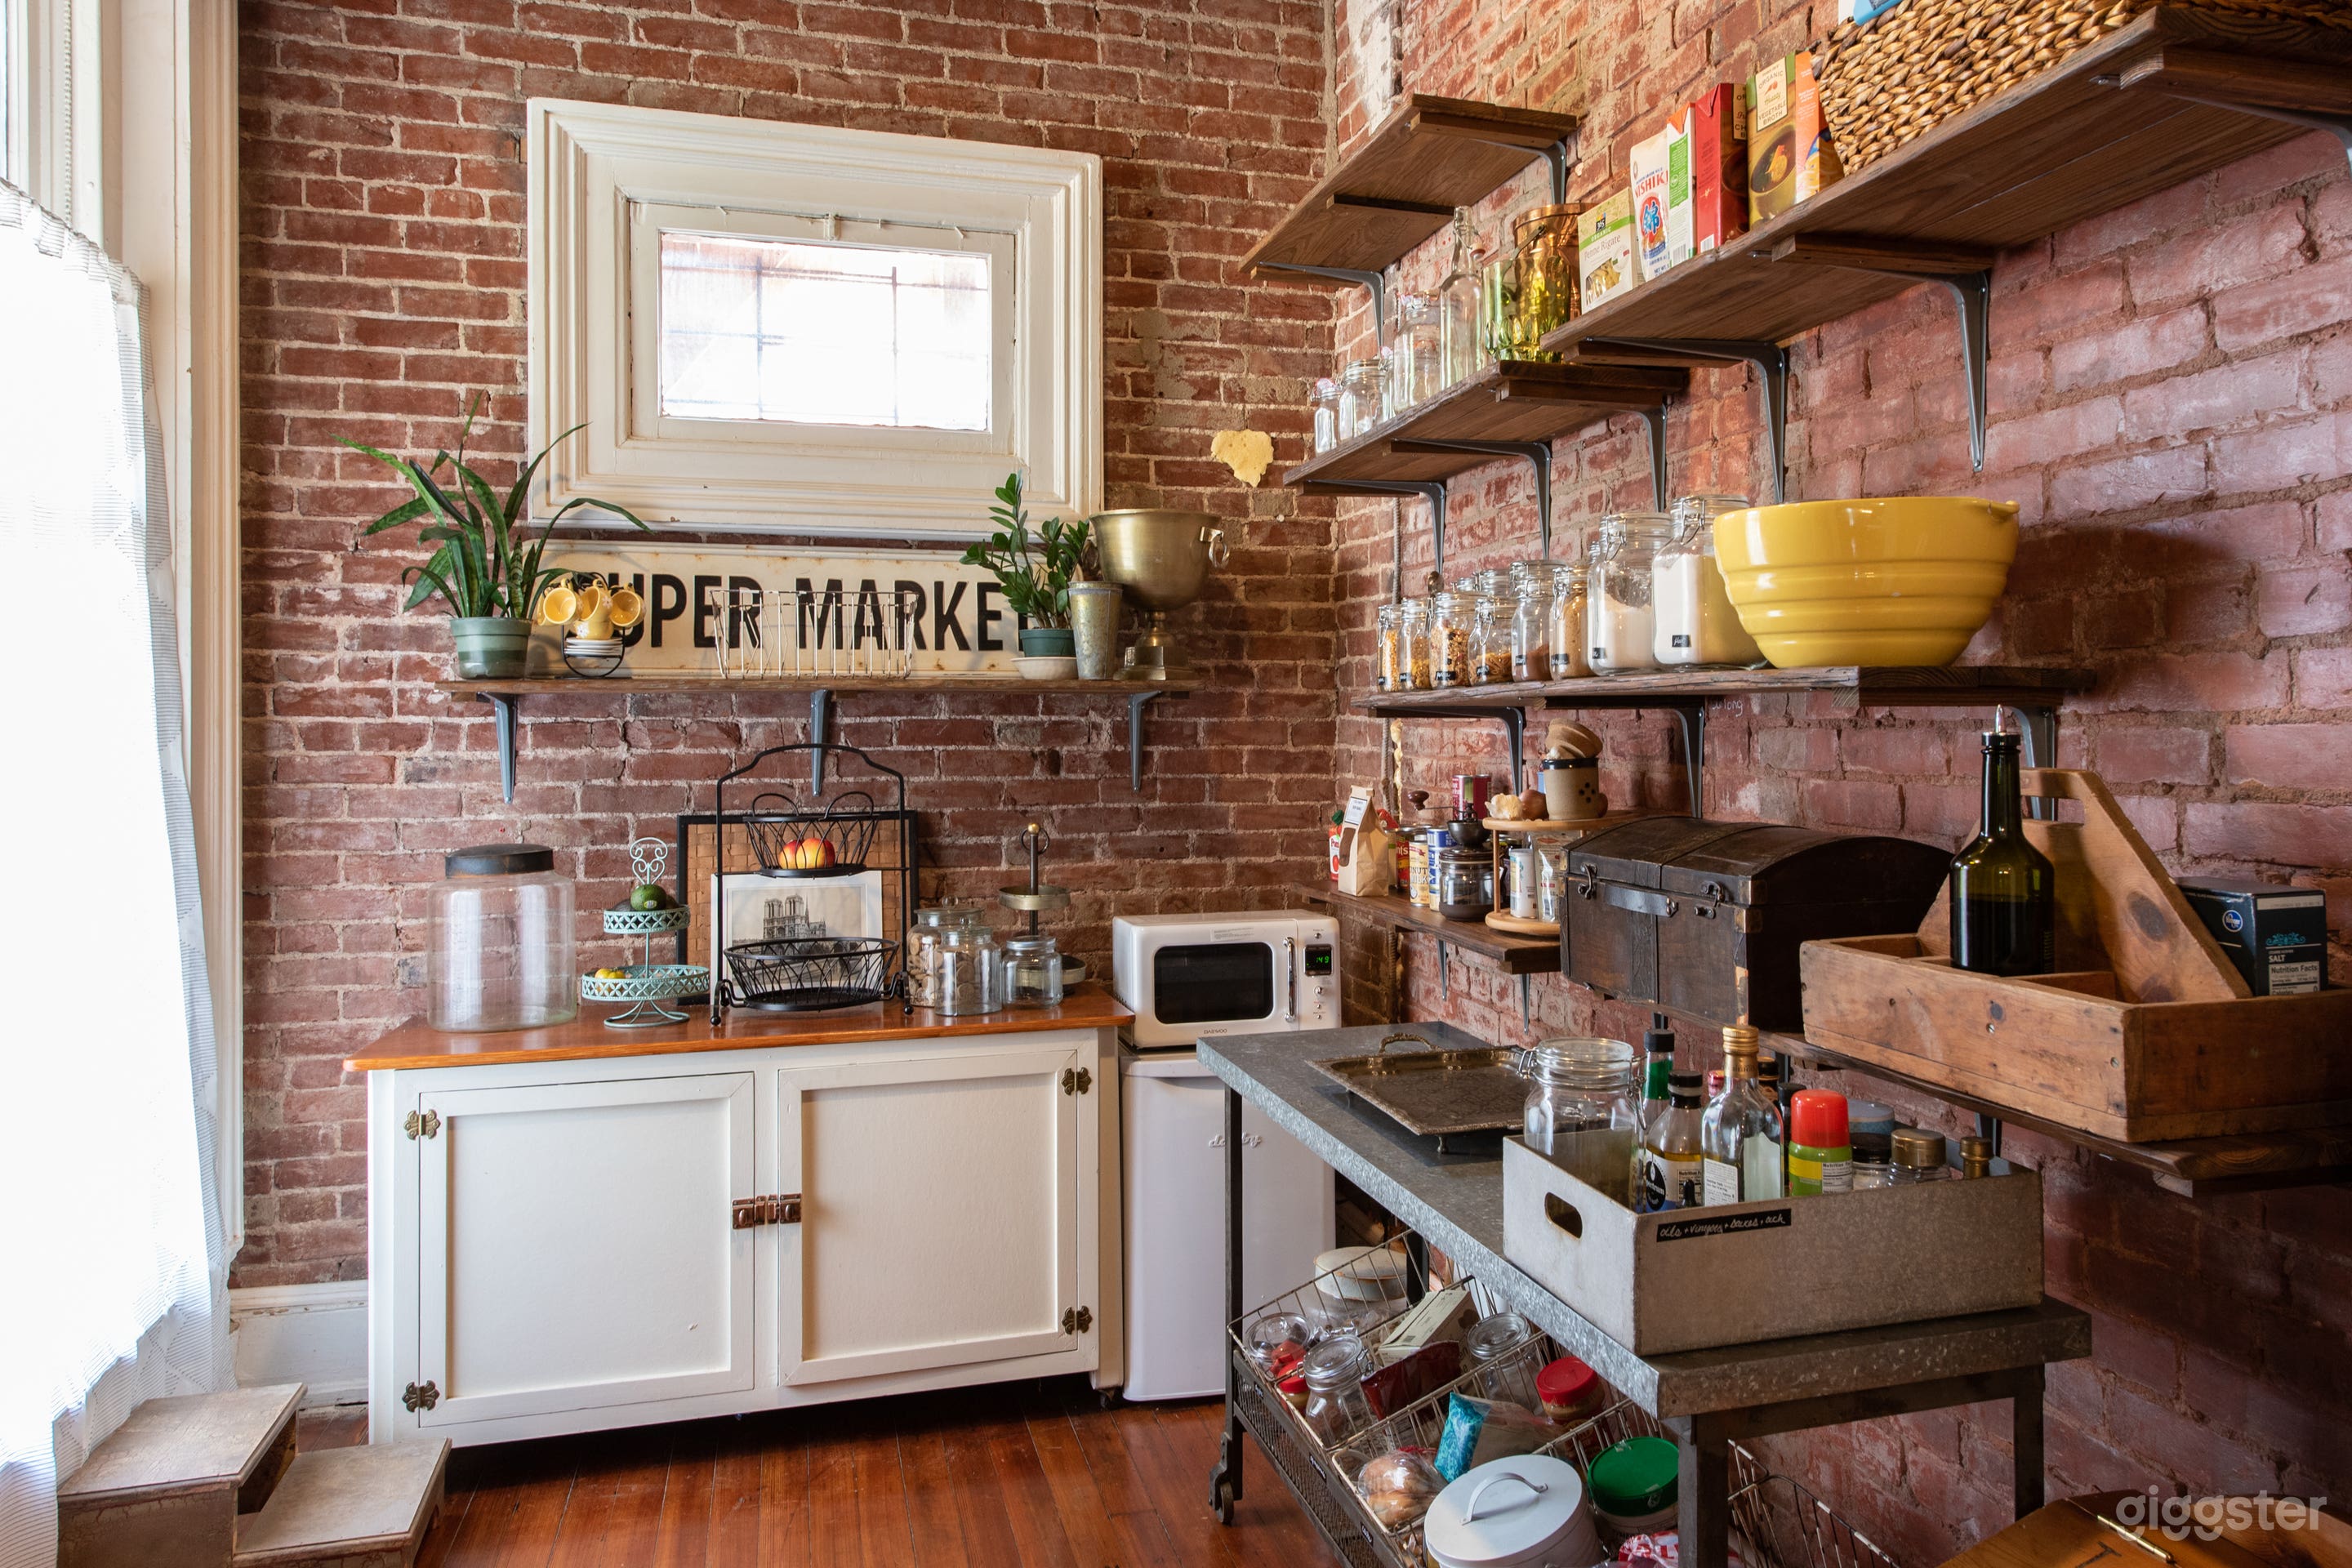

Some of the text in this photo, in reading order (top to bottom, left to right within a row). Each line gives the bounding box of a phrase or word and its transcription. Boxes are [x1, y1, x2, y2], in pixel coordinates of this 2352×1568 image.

[1758, 70, 1784, 89] ORGANIC
[1758, 100, 1787, 120] VEGETABLE
[1762, 110, 1784, 125] BROTH
[1634, 169, 1668, 197] NISHIKI
[1601, 234, 1621, 251] Rigate
[567, 572, 764, 648] UPER
[2269, 955, 2286, 963] SALT
[2271, 964, 2318, 974] Nutrition Facts
